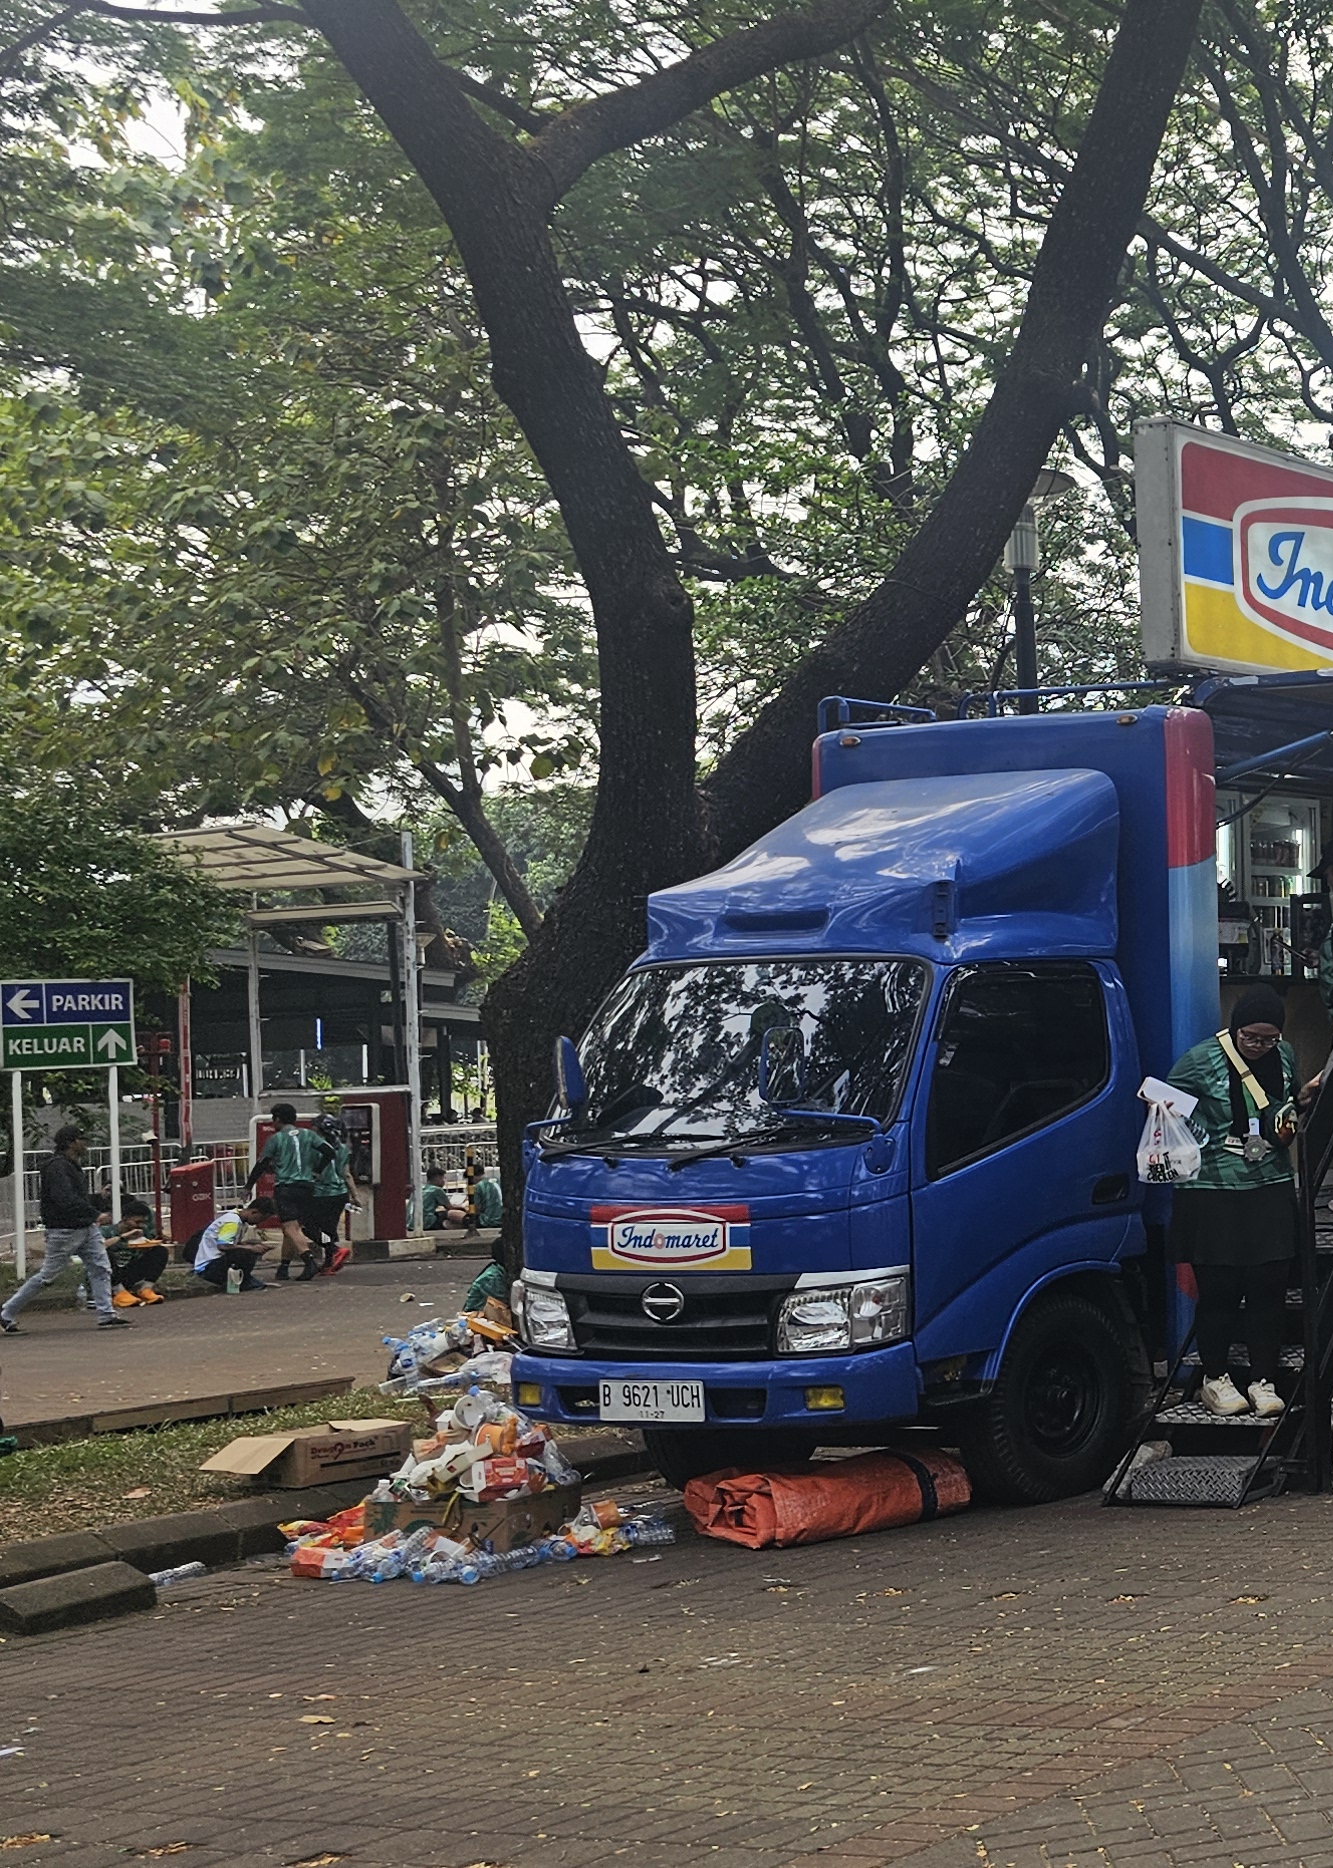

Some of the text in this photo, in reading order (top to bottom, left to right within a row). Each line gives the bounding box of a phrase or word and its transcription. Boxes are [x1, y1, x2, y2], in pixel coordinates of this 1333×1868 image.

[52, 993, 124, 1011] PARKIR
[8, 1037, 85, 1055] KELUAR
[616, 1224, 720, 1250] Indomaret
[603, 1384, 701, 1408] B 9621 UCH
[638, 1410, 665, 1419] 11-27
